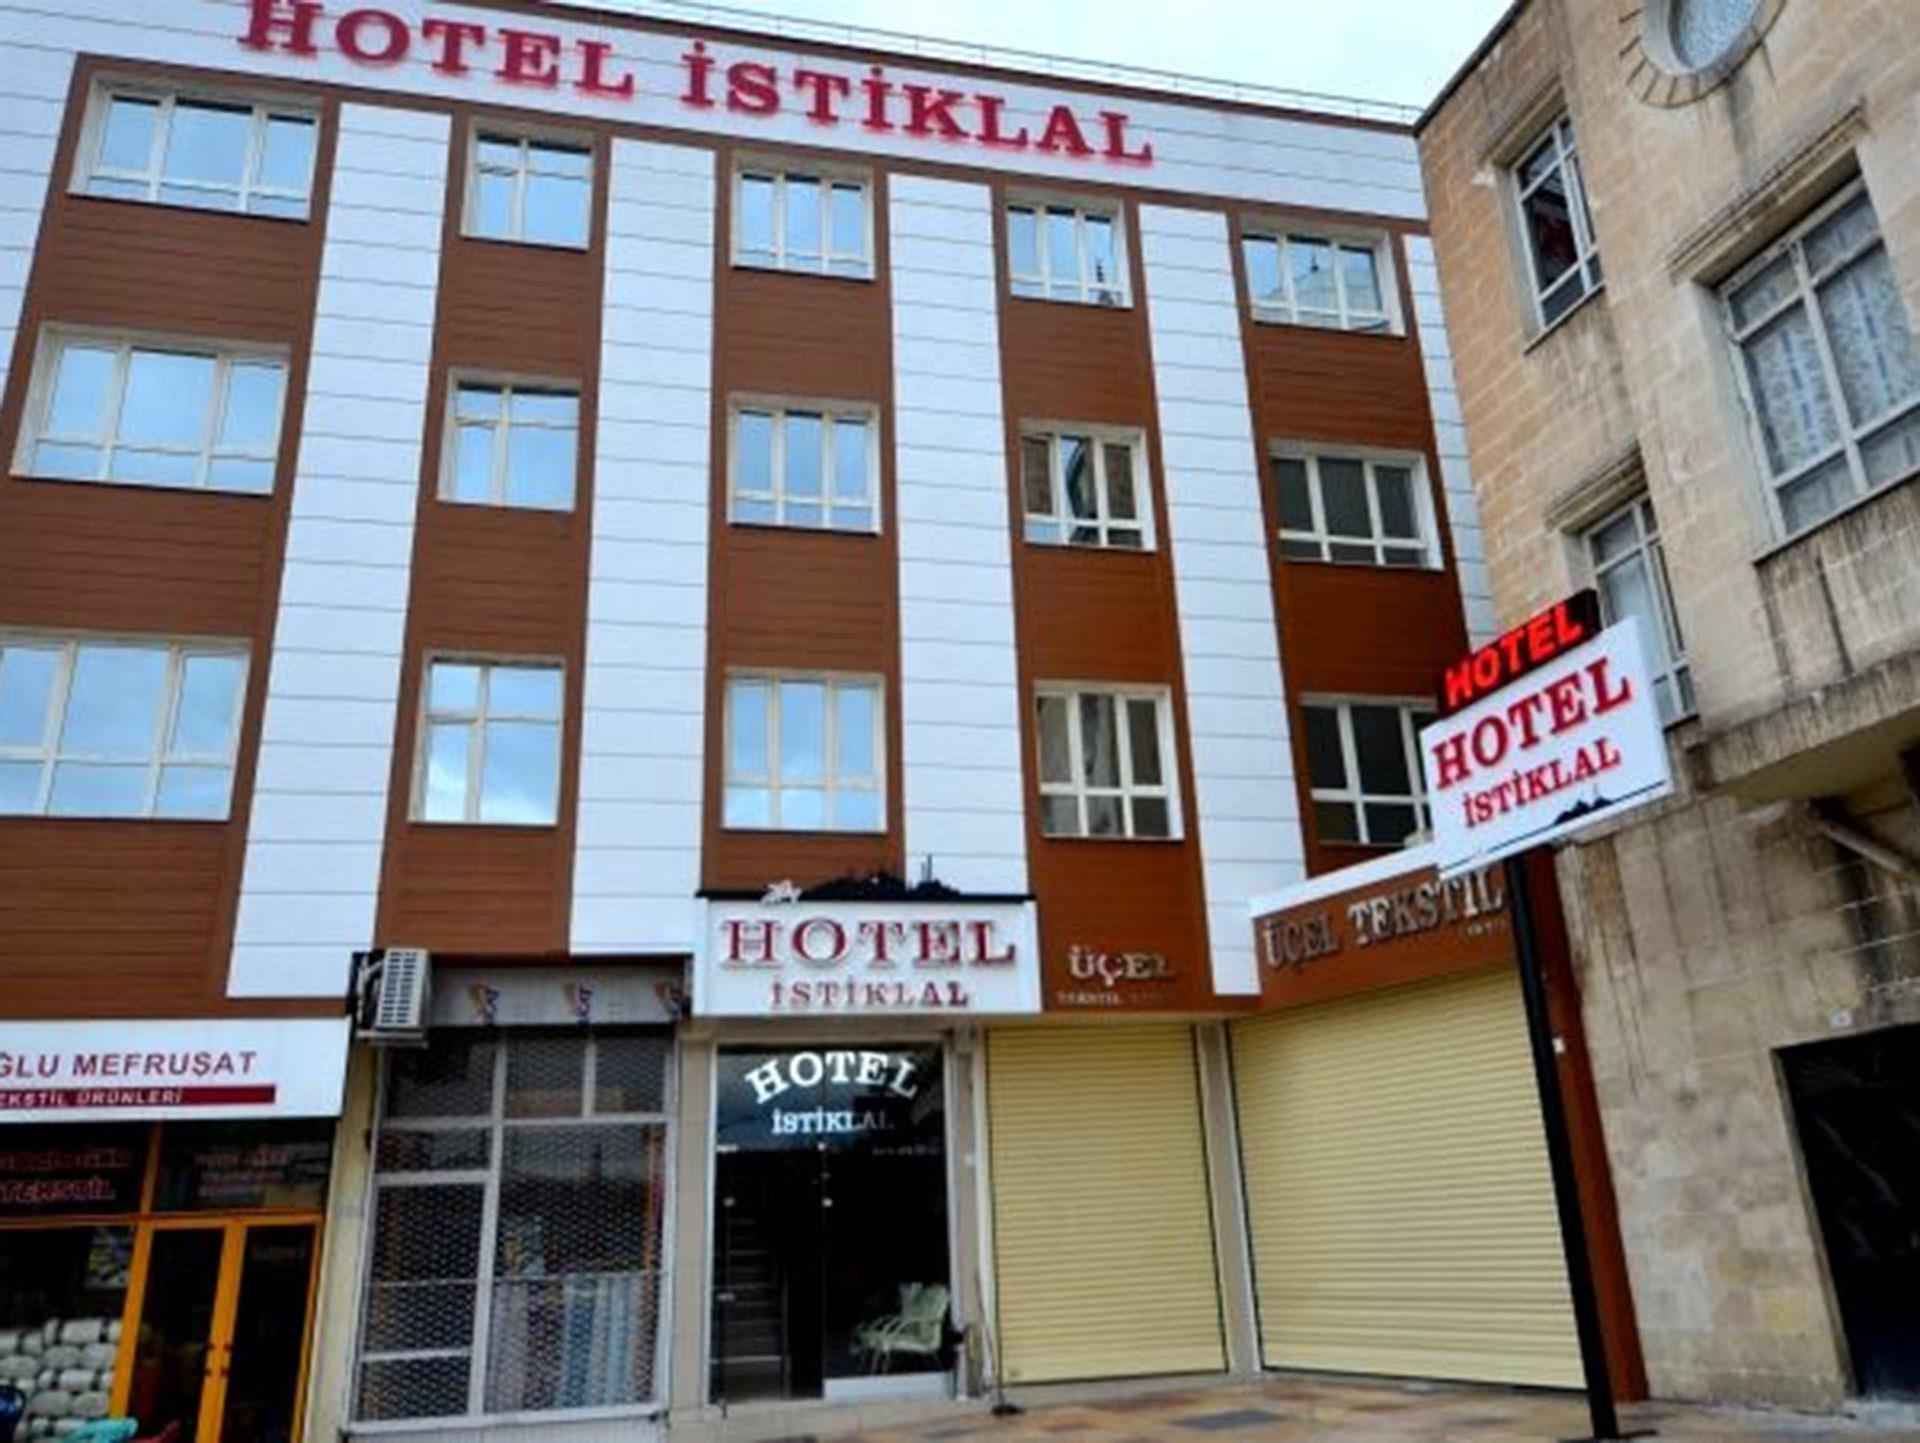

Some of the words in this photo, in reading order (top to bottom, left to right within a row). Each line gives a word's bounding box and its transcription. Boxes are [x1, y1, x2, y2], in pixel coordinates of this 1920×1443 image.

[238, 0, 634, 96] HOTEL
[680, 40, 1154, 163] İSTİKLAL
[1445, 602, 1584, 707] HOTEL
[1432, 656, 1633, 790] HOTEL
[1462, 737, 1622, 828] İSTİKLAL
[720, 916, 1017, 969] HOTEL
[771, 973, 970, 1009] İSTİKLAL
[744, 1051, 918, 1105] HOTEL
